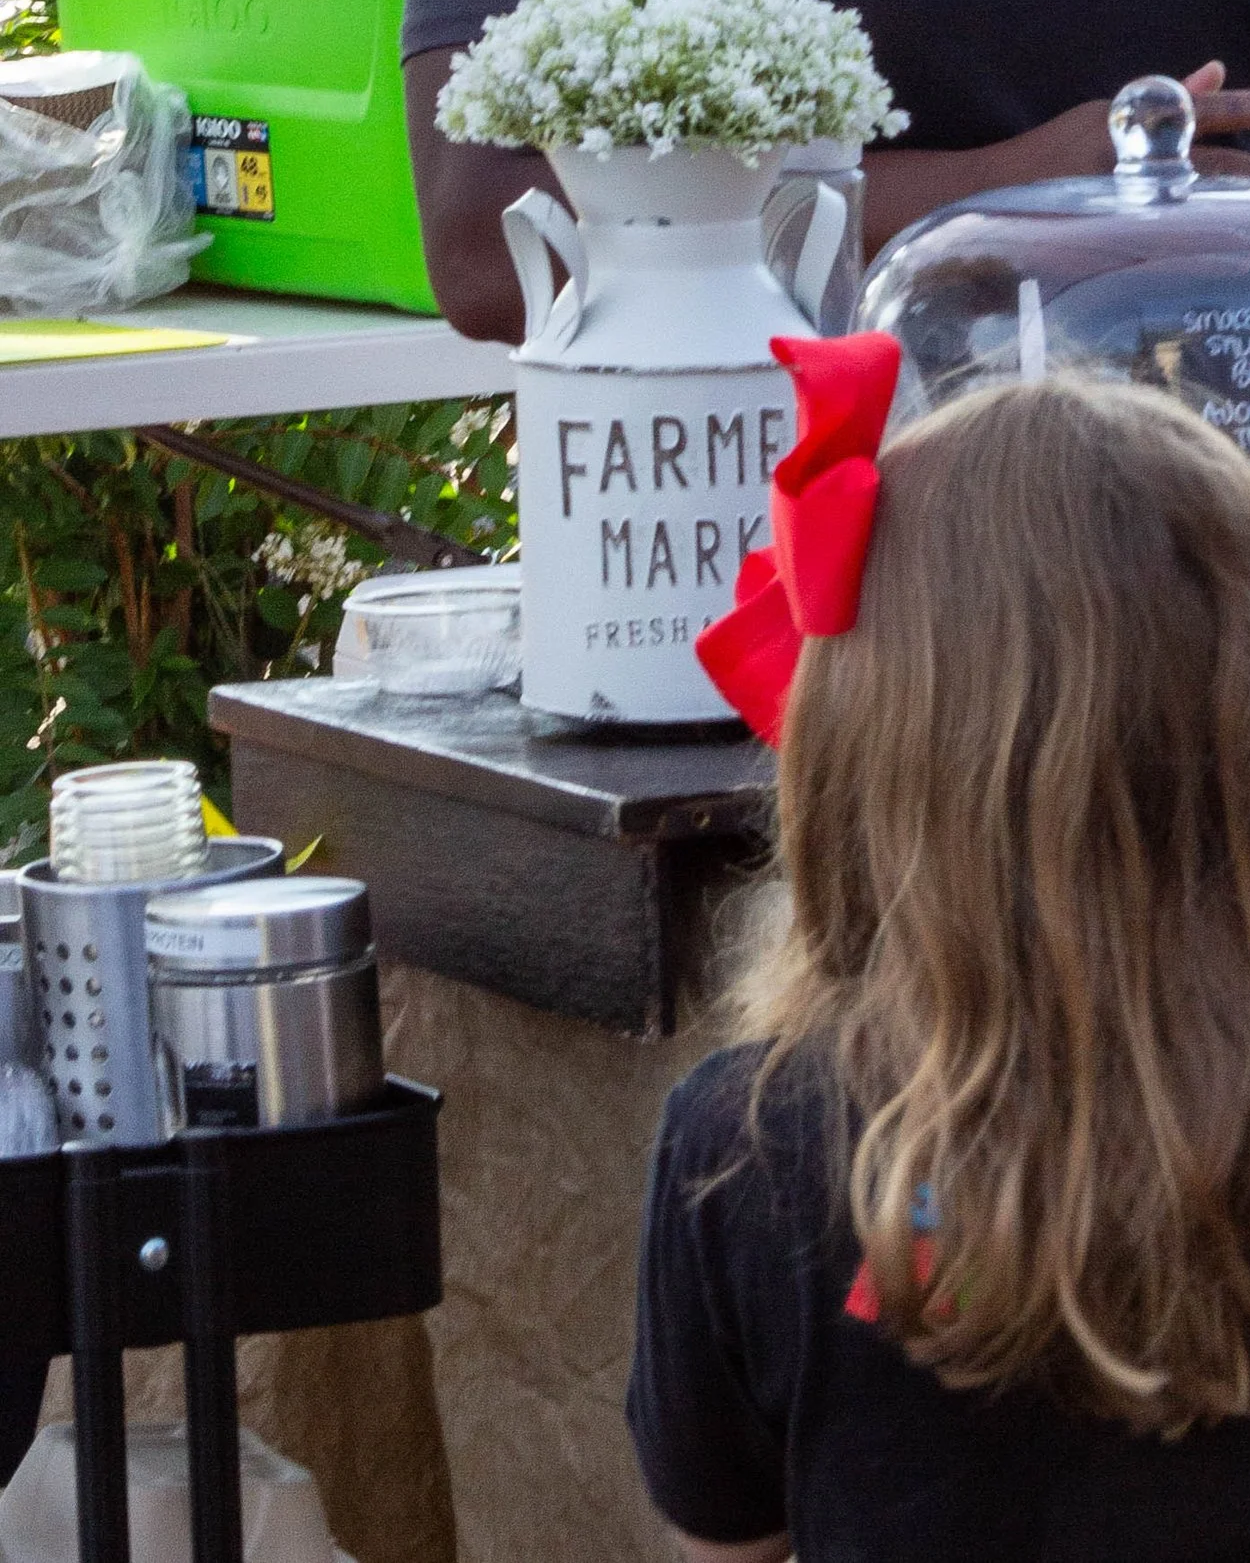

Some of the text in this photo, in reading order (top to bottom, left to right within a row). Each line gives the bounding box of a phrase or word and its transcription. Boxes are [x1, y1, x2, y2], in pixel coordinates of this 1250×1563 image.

[557, 407, 786, 519] FARME
[601, 513, 765, 589] MARK
[585, 615, 691, 651] FRESH
